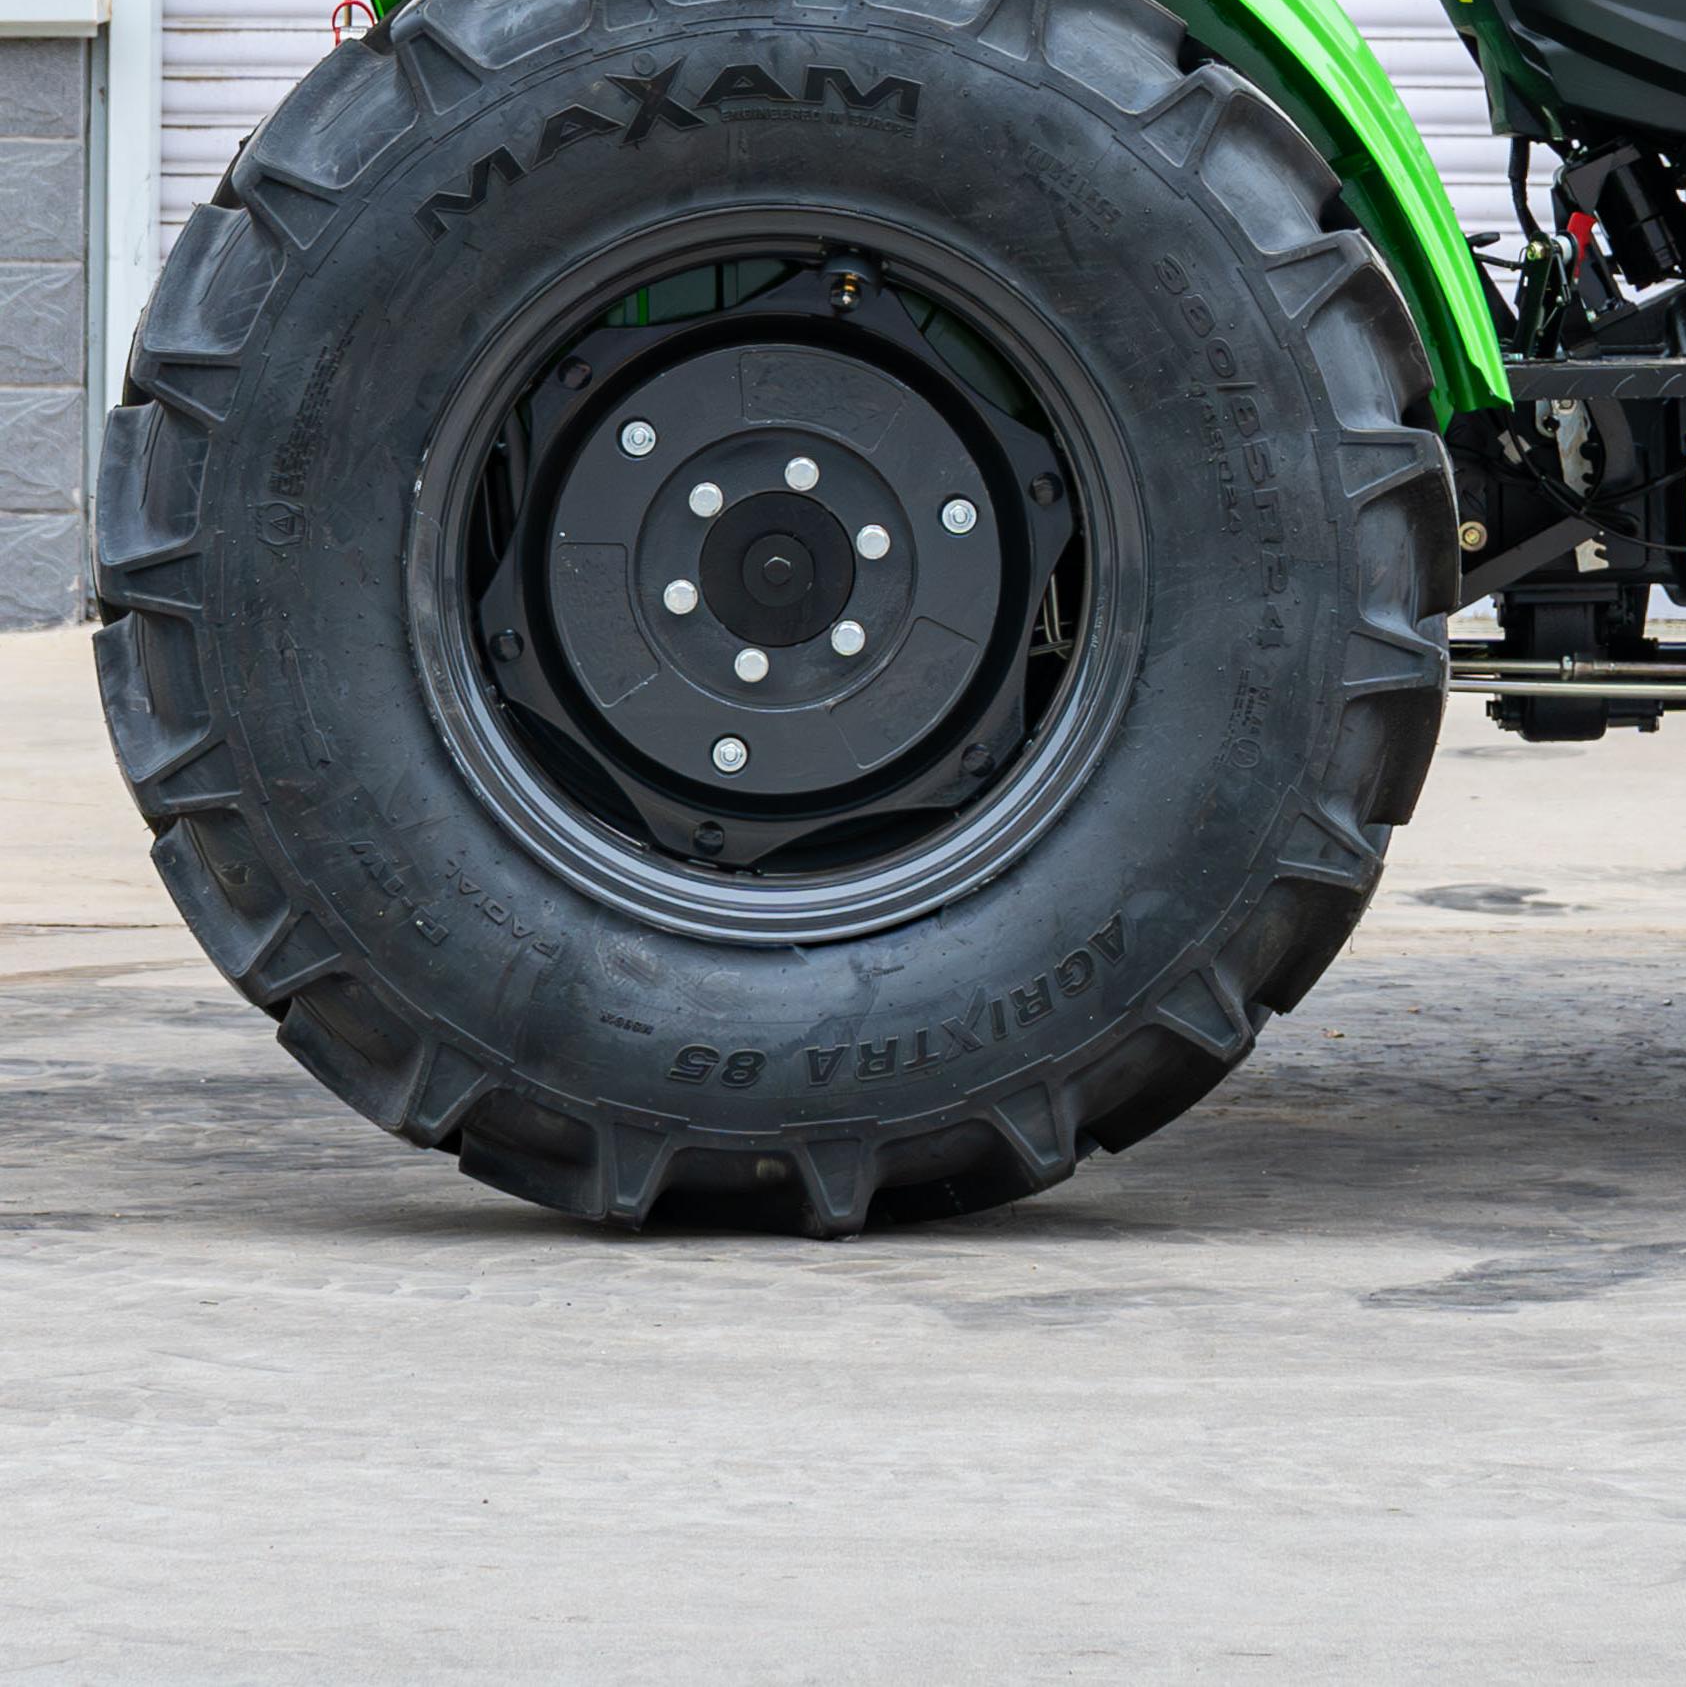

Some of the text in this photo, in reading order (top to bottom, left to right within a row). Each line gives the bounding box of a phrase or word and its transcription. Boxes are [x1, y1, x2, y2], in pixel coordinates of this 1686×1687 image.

[413, 56, 924, 244] MAXAM
[445, 858, 562, 959] RADIAL
[664, 907, 1128, 1088] AGRIXTRA 85
